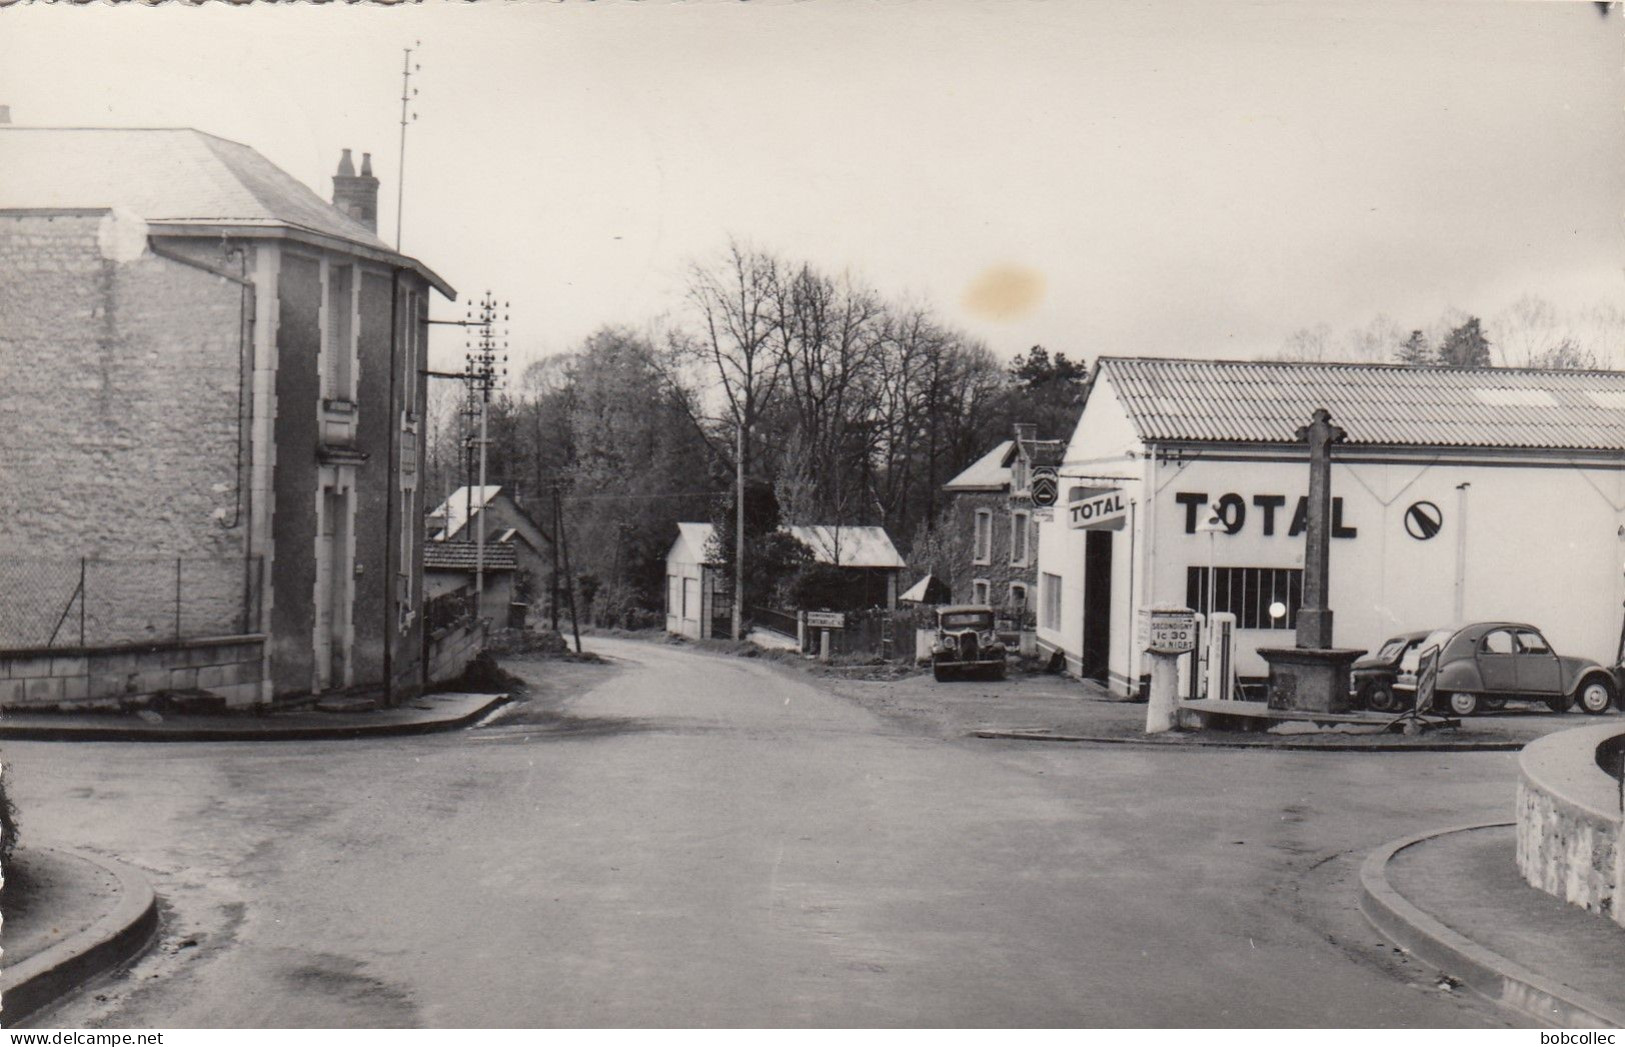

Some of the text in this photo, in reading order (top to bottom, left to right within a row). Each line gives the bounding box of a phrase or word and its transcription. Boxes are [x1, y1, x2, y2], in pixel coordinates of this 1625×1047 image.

[1070, 496, 1125, 523] TOTAL
[1152, 622, 1193, 630] SECONDIGNY
[1171, 631, 1187, 640] 30
